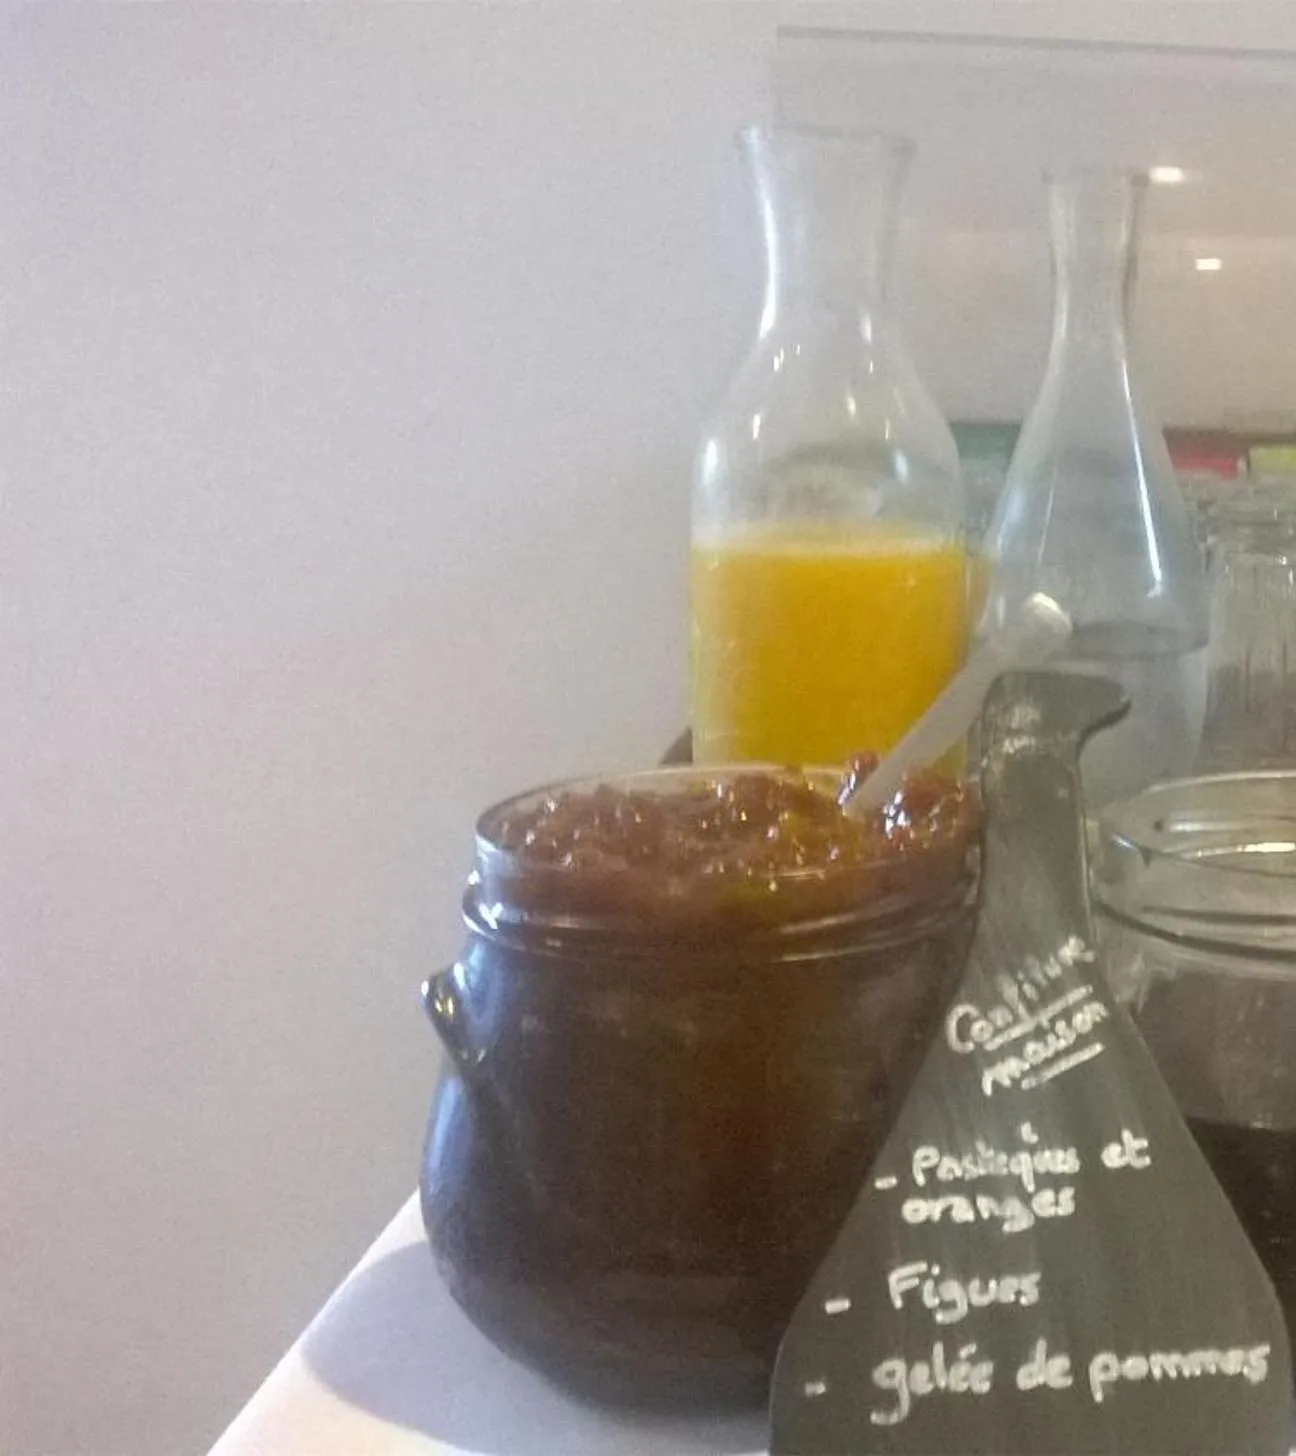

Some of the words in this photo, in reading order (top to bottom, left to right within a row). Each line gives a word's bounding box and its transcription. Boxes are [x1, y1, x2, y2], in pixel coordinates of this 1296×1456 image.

[982, 1002, 1109, 1096] maison
[1101, 1129, 1152, 1170] et
[902, 1186, 1076, 1233] oranges
[888, 1262, 1042, 1324] Figues
[870, 1341, 995, 1425] gelée
[1016, 1337, 1074, 1391] de
[1089, 1343, 1271, 1402] pommes
